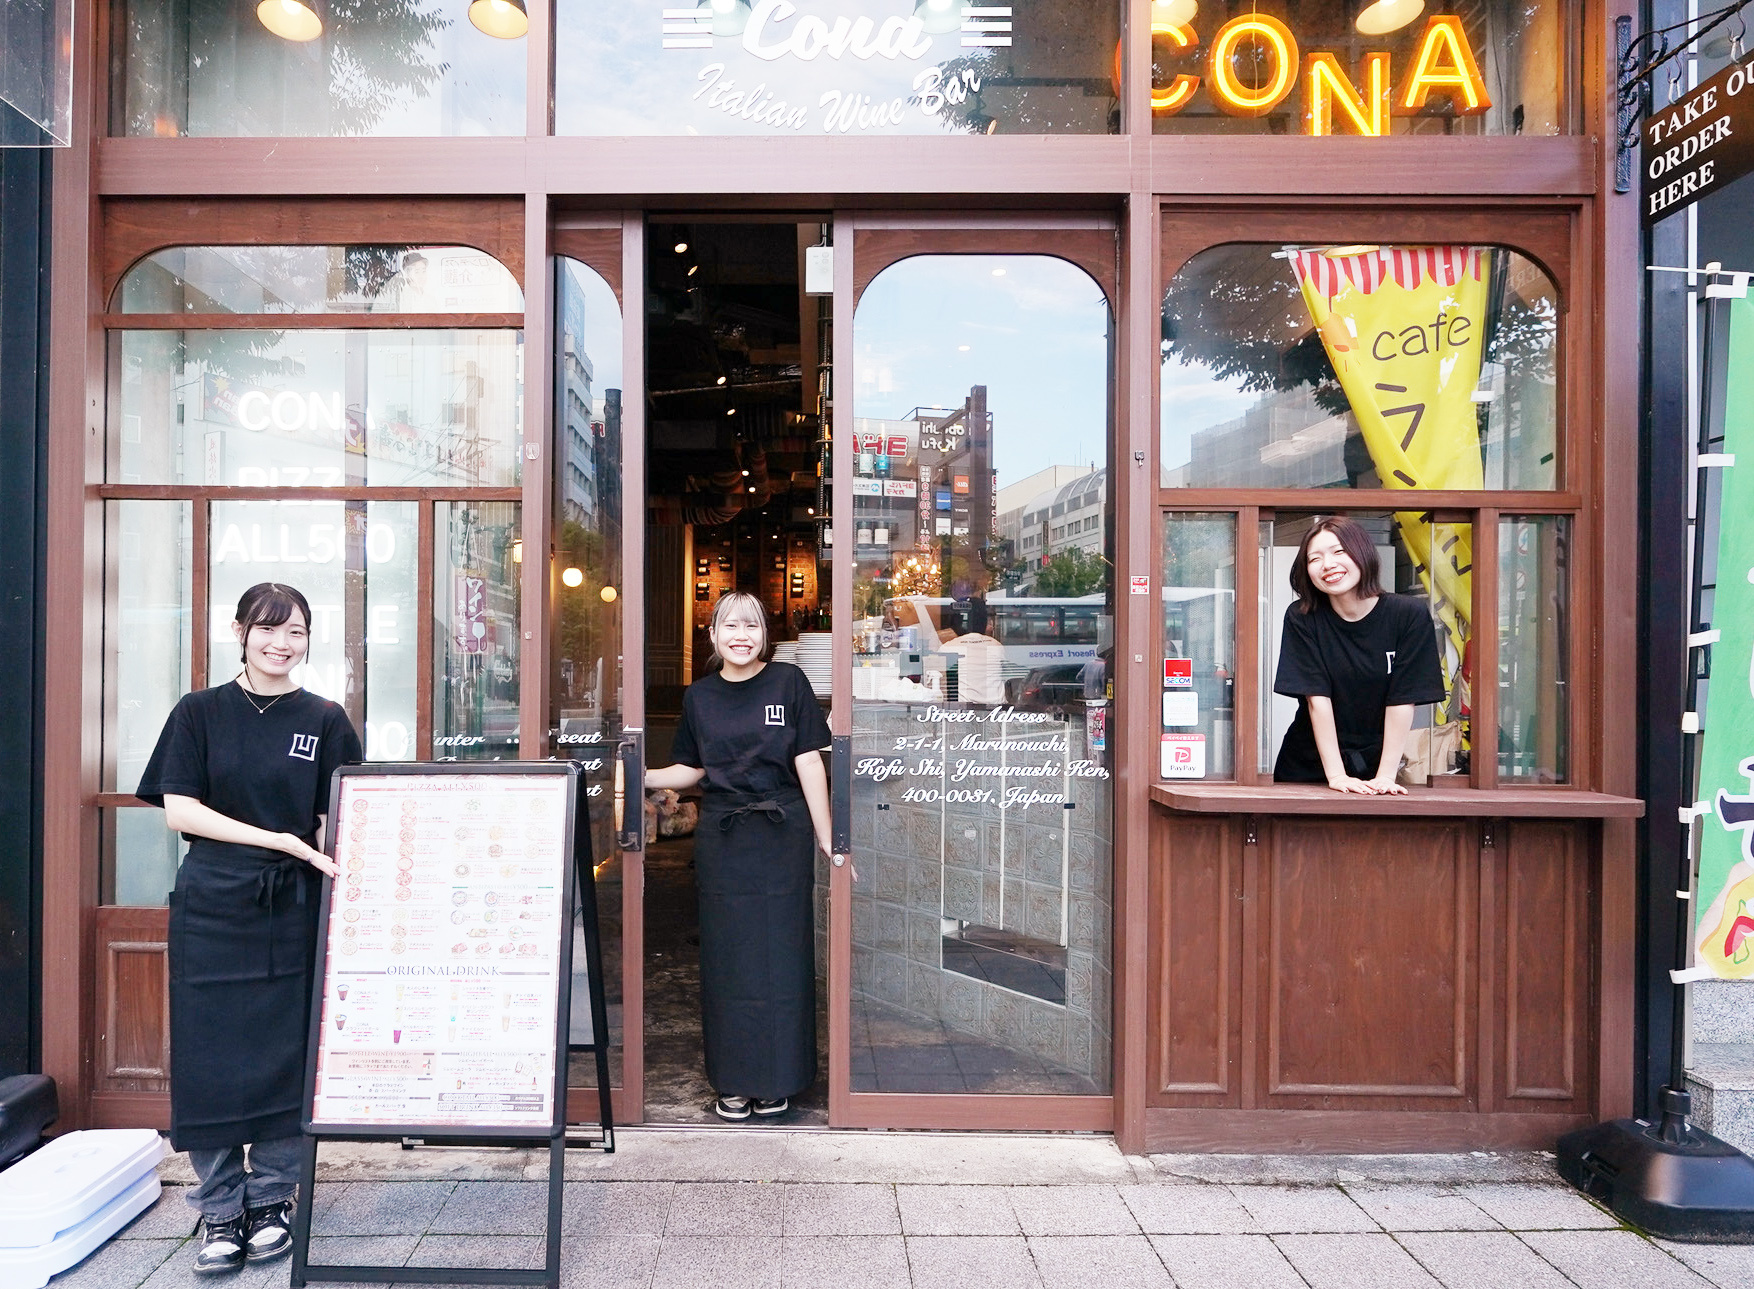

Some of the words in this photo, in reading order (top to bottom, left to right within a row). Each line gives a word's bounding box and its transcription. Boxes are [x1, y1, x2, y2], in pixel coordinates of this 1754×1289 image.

[742, 0, 934, 61] Cona
[1152, 14, 1492, 137] CONA
[692, 62, 807, 131] Italian
[819, 88, 906, 133] Wine
[912, 65, 981, 117] Bar
[1649, 84, 1717, 145] TAKE
[1648, 115, 1733, 180] ORDER
[1648, 160, 1715, 216] HERE
[1372, 310, 1472, 362] cafe
[238, 391, 375, 432] CON
[466, 576, 484, 622] ワイン
[916, 705, 975, 724] Street
[976, 706, 1048, 723] Adress
[557, 731, 603, 744] seat
[892, 736, 945, 754] 2-1-1,
[949, 734, 1070, 754] Marunouchi,
[854, 758, 907, 782] Kofu
[908, 758, 946, 778] Shi,
[950, 758, 1061, 782] Yamanashi
[1063, 759, 1111, 781] Ken,
[1170, 765, 1196, 773] PayPay
[998, 786, 1066, 810] Japan
[386, 965, 452, 976] ORIGINAL
[456, 965, 501, 976] DRINK
